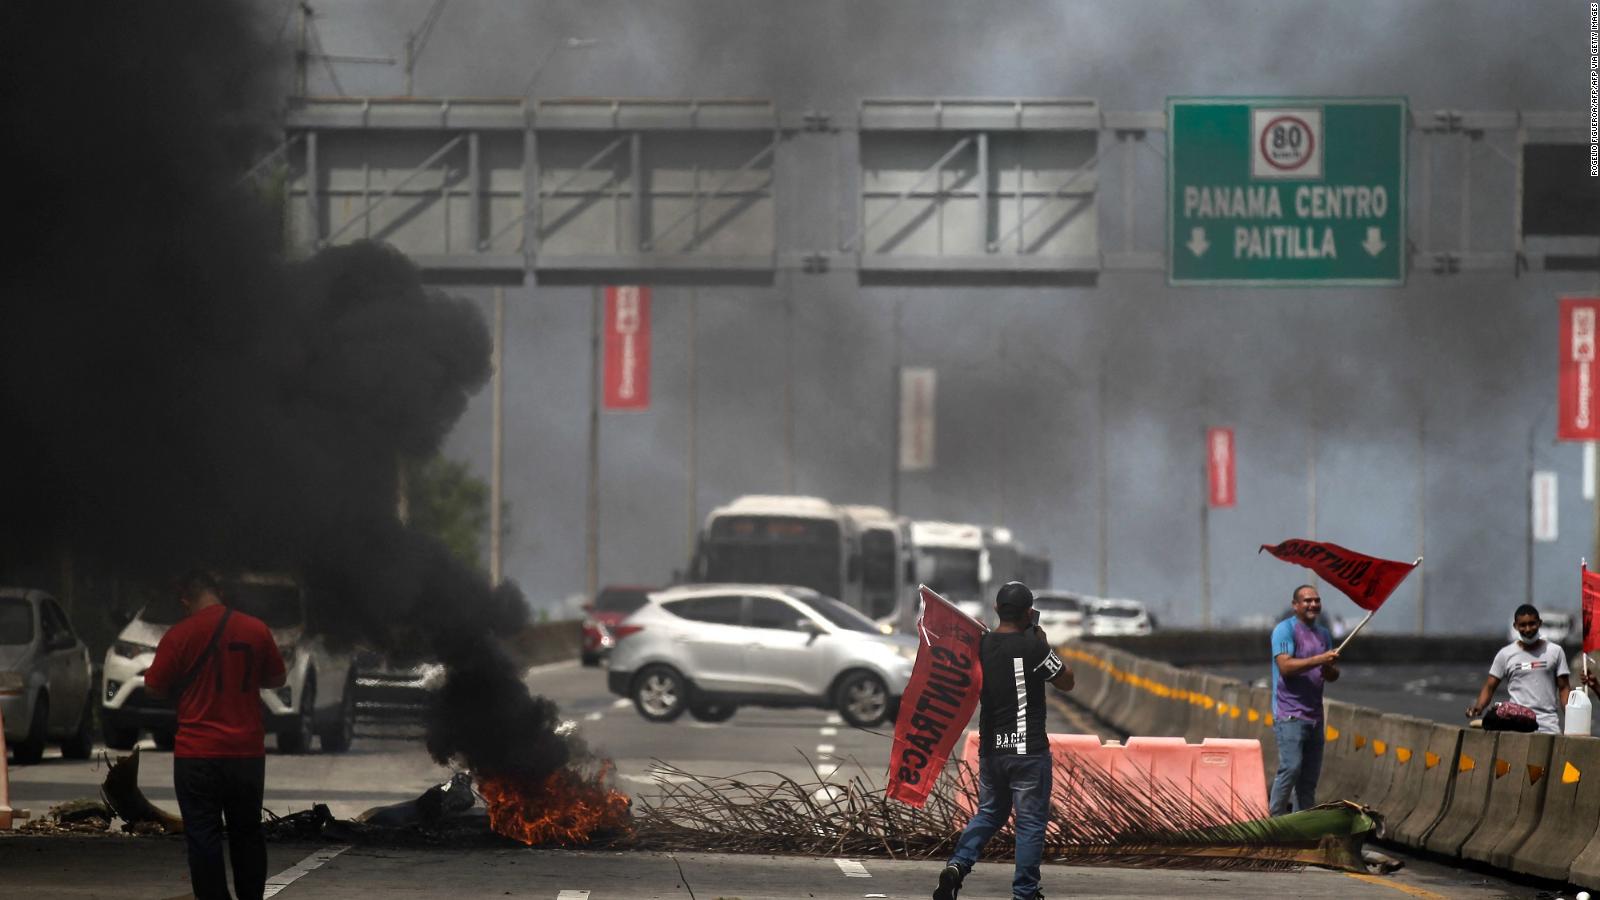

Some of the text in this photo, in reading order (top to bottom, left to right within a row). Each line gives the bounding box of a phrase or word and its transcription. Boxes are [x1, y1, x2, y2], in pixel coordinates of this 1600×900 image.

[1273, 126, 1301, 149] 80
[1184, 186, 1387, 218] PANAMA CENTRO
[1235, 226, 1336, 258] PAITILLA
